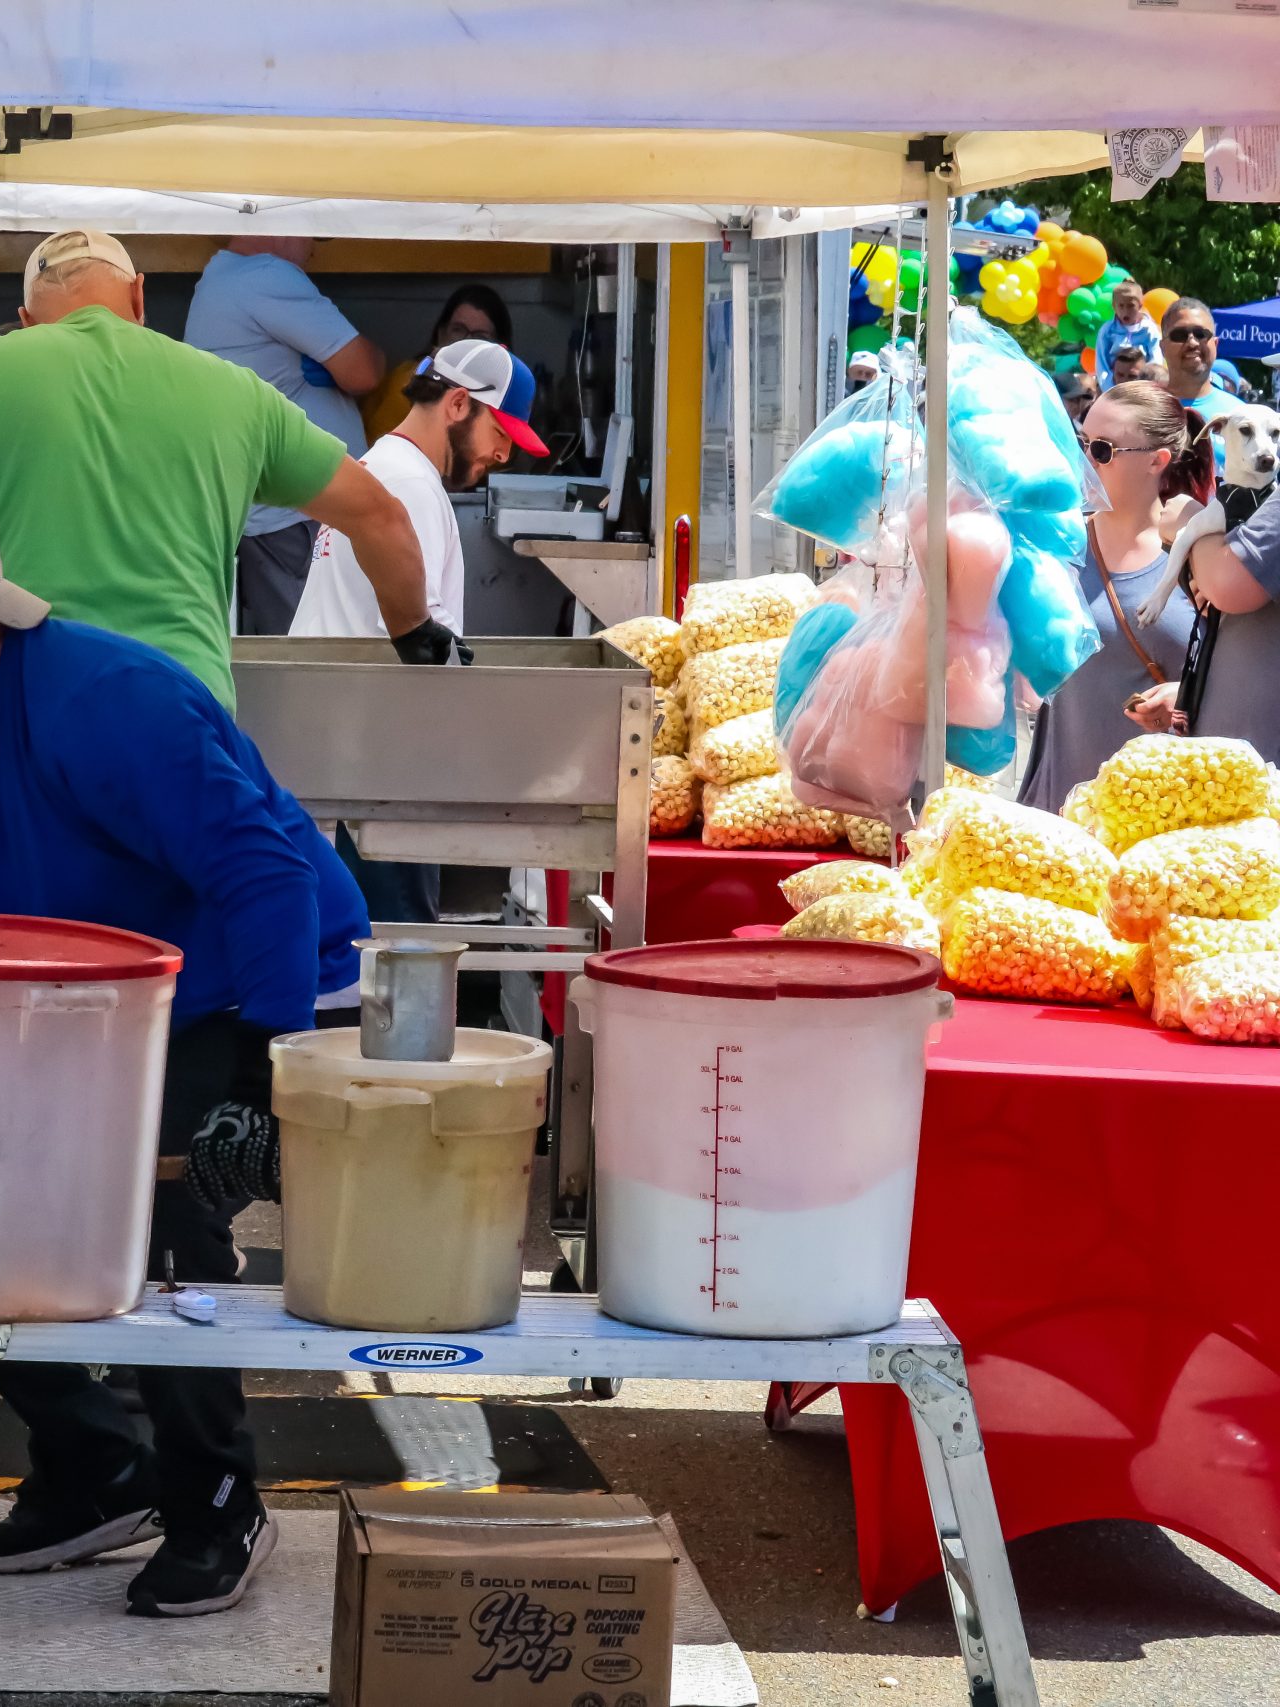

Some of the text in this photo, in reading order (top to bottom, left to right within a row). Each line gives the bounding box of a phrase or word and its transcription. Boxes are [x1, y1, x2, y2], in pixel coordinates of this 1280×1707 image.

[377, 1350, 458, 1360] WERNER
[386, 1569, 455, 1579] COOKS DIRECTLY
[409, 1581, 441, 1589] POPPER
[480, 1578, 591, 1590] GOLD MEDAL
[584, 1610, 646, 1620] POPCORN
[586, 1623, 640, 1634] COATING
[599, 1637, 624, 1648] MIX
